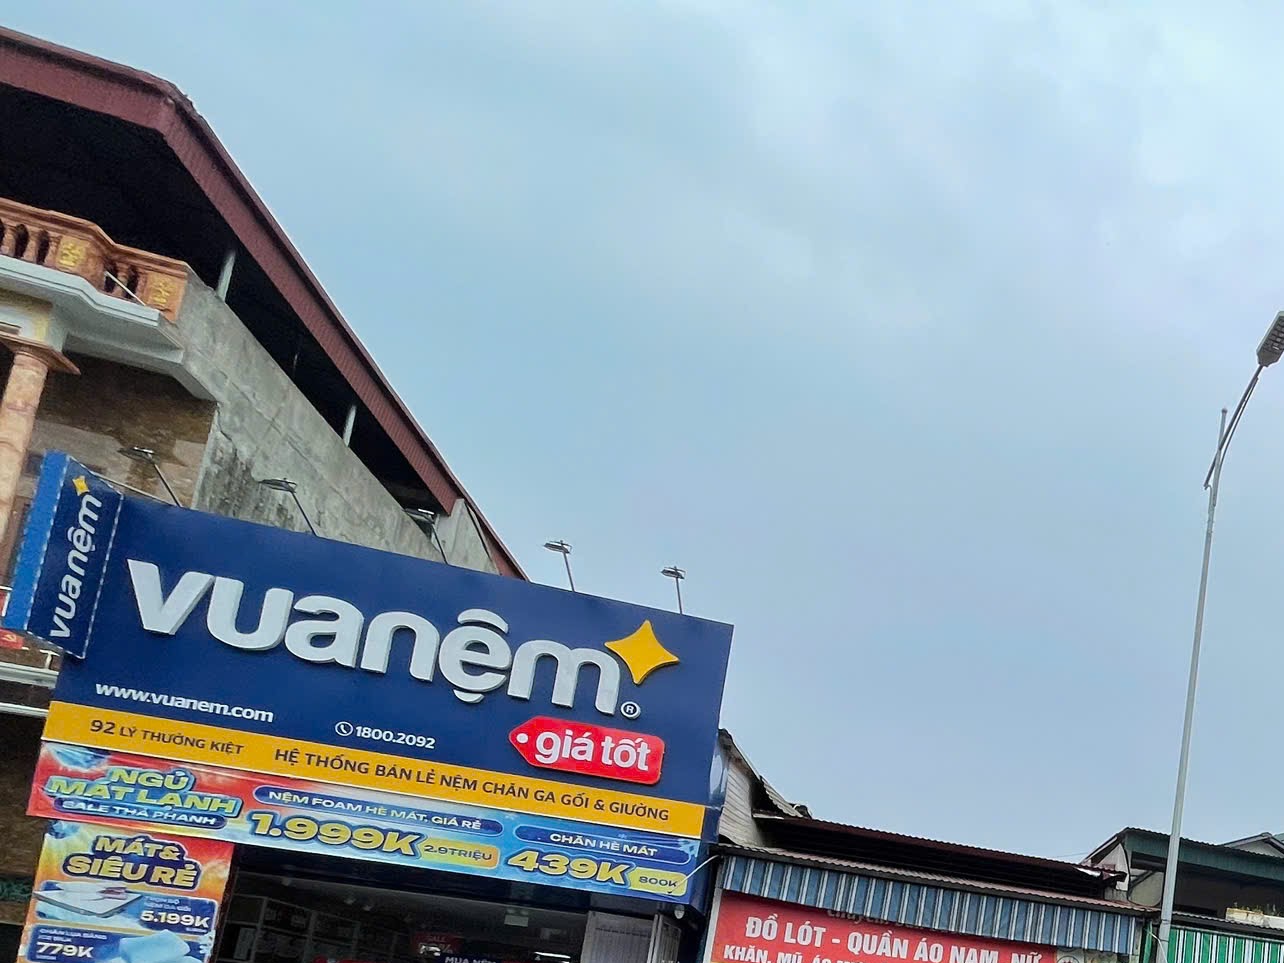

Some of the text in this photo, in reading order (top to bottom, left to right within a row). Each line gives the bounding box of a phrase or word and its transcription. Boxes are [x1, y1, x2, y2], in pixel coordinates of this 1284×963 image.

[50, 494, 102, 638] vuanệm
[127, 558, 622, 716] vuanệm
[95, 683, 274, 722] www.vuanem.com
[90, 719, 115, 735] 92
[119, 725, 137, 738] LÝ
[210, 740, 244, 755] KIỆT
[355, 725, 435, 750] 1800.2092
[535, 731, 651, 771] giá tốt
[51, 778, 236, 813] MÁT LẠNH
[275, 748, 669, 821] HỆ THỐNG BÁN LẺ NỆM CHĂN GA GỐI & GIƯỜNG
[62, 801, 108, 813] SALE
[152, 811, 216, 825] PHANH
[269, 791, 309, 805] NỆM
[312, 798, 364, 812] FOAM
[432, 814, 459, 827] GIÁ
[251, 813, 421, 856] 1.999K
[550, 832, 658, 857] CHĂN HÈ MÁT
[66, 855, 148, 881] SIÊU
[508, 850, 628, 885] 439K
[140, 910, 211, 928] 5.199K
[36, 942, 94, 958] 779K
[745, 913, 779, 941] ĐỒ
[784, 920, 826, 948] LÓT
[847, 929, 908, 960] QUẦN
[913, 937, 944, 963] ÁO
